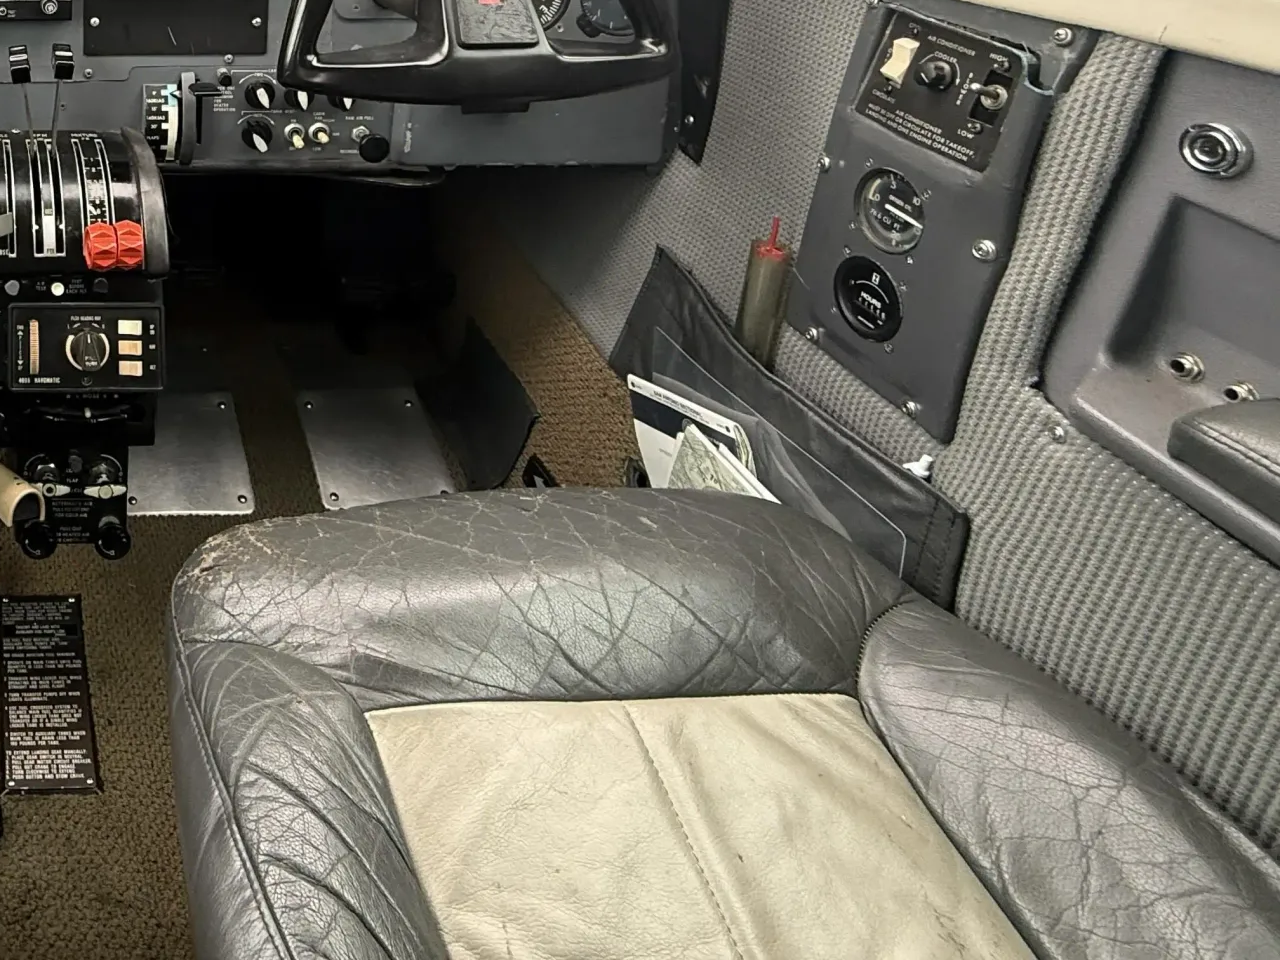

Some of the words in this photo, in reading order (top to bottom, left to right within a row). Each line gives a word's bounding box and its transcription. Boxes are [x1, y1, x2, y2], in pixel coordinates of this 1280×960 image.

[927, 34, 937, 43] AIR
[936, 37, 976, 57] CONDITIONER
[934, 50, 958, 63] COOLER
[989, 52, 1009, 62] HIGH
[895, 109, 905, 118] AIR
[904, 113, 943, 134] CONDITIONER
[865, 109, 887, 123] LANDING
[897, 125, 909, 136] ONE
[909, 131, 932, 146] ENGINE
[932, 141, 969, 162] OPERATION
[902, 119, 932, 138] CIRCULATE
[932, 133, 945, 144] FOR
[945, 140, 975, 159] TAKEOFF,
[957, 128, 975, 139] LOW
[882, 215, 892, 225] CU
[860, 291, 882, 309] HOURS
